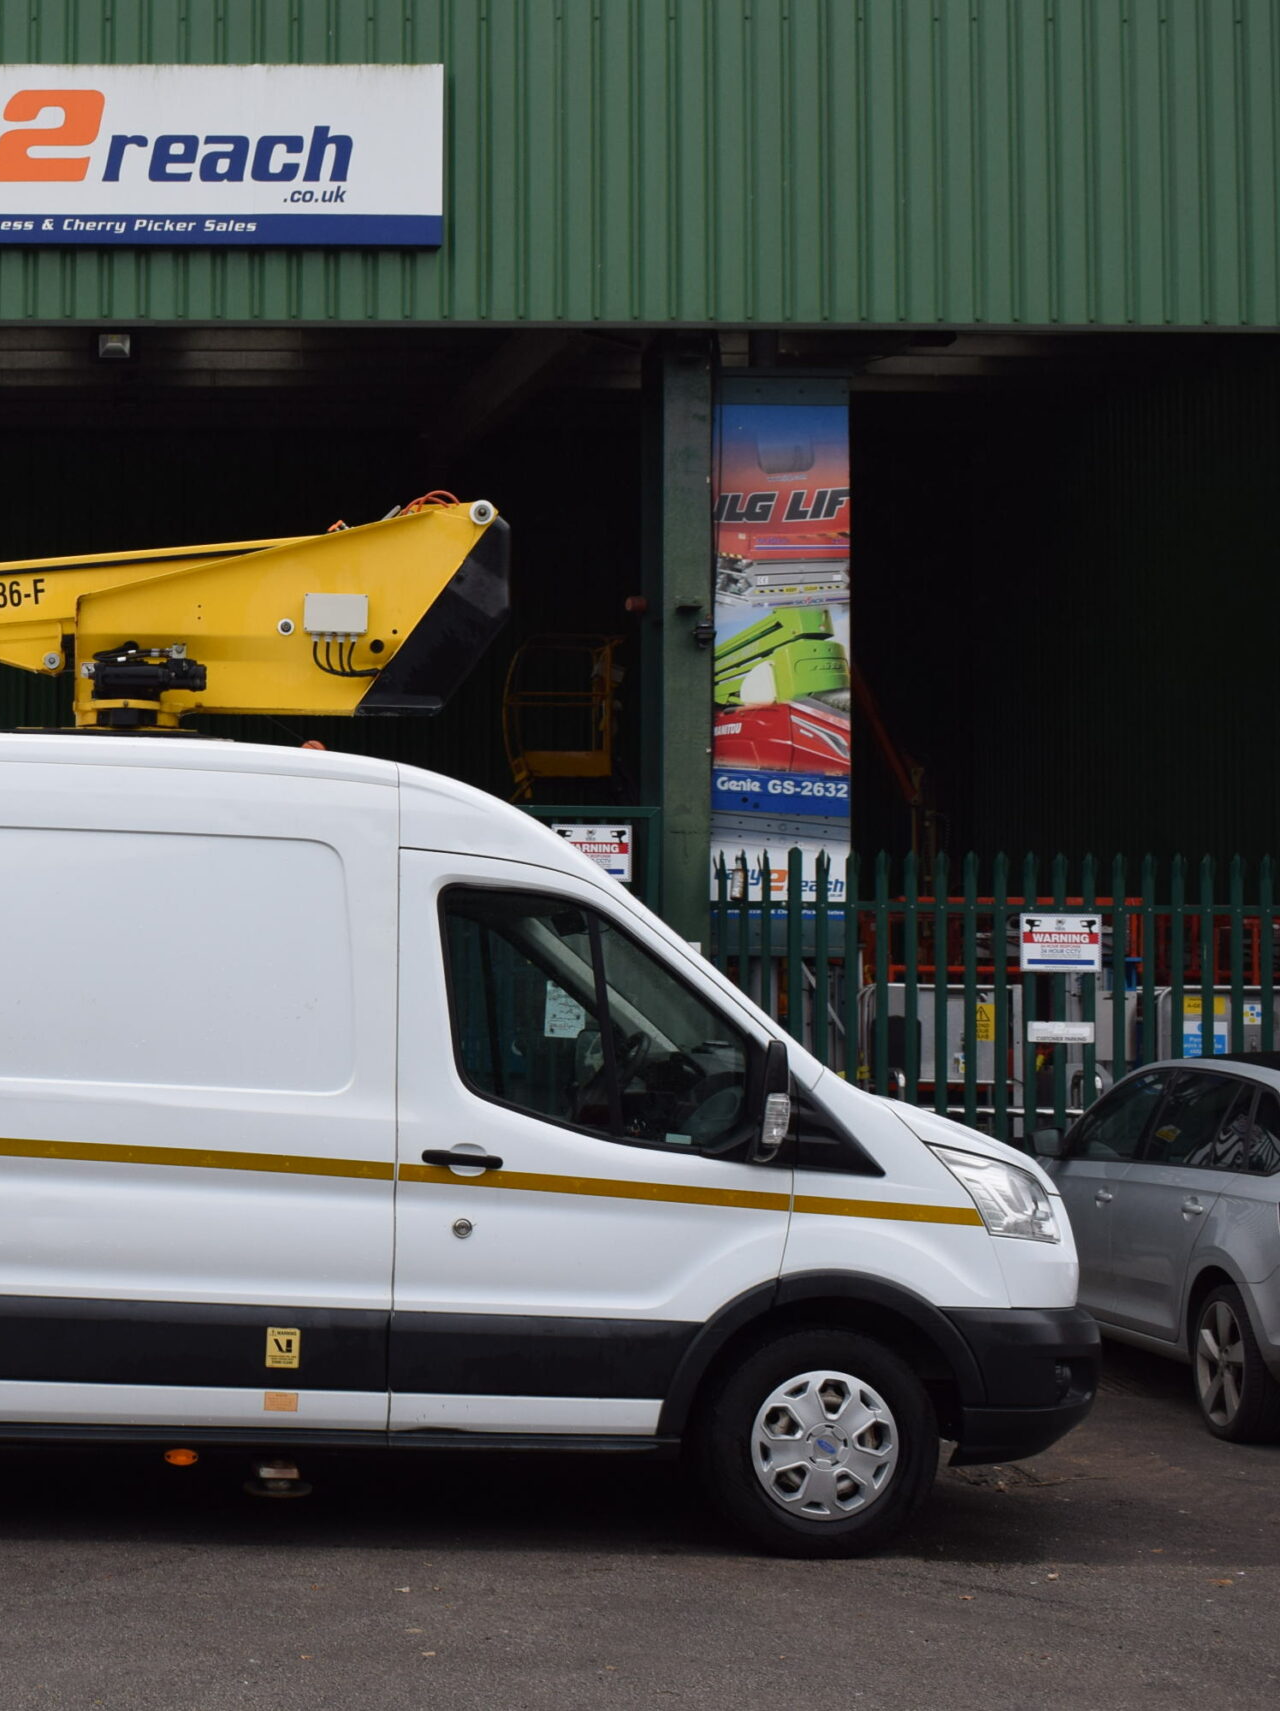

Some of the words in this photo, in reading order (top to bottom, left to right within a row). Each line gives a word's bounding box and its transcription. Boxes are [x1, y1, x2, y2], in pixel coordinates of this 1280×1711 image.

[282, 185, 347, 204] .co.uk
[41, 218, 55, 231] &
[62, 218, 127, 234] Cherry
[133, 219, 197, 232] Picker
[203, 219, 258, 232] Sales
[716, 776, 762, 792] Genie
[767, 779, 849, 798] GS-2632
[575, 843, 620, 853] ARNING
[1032, 933, 1090, 944] WARNING
